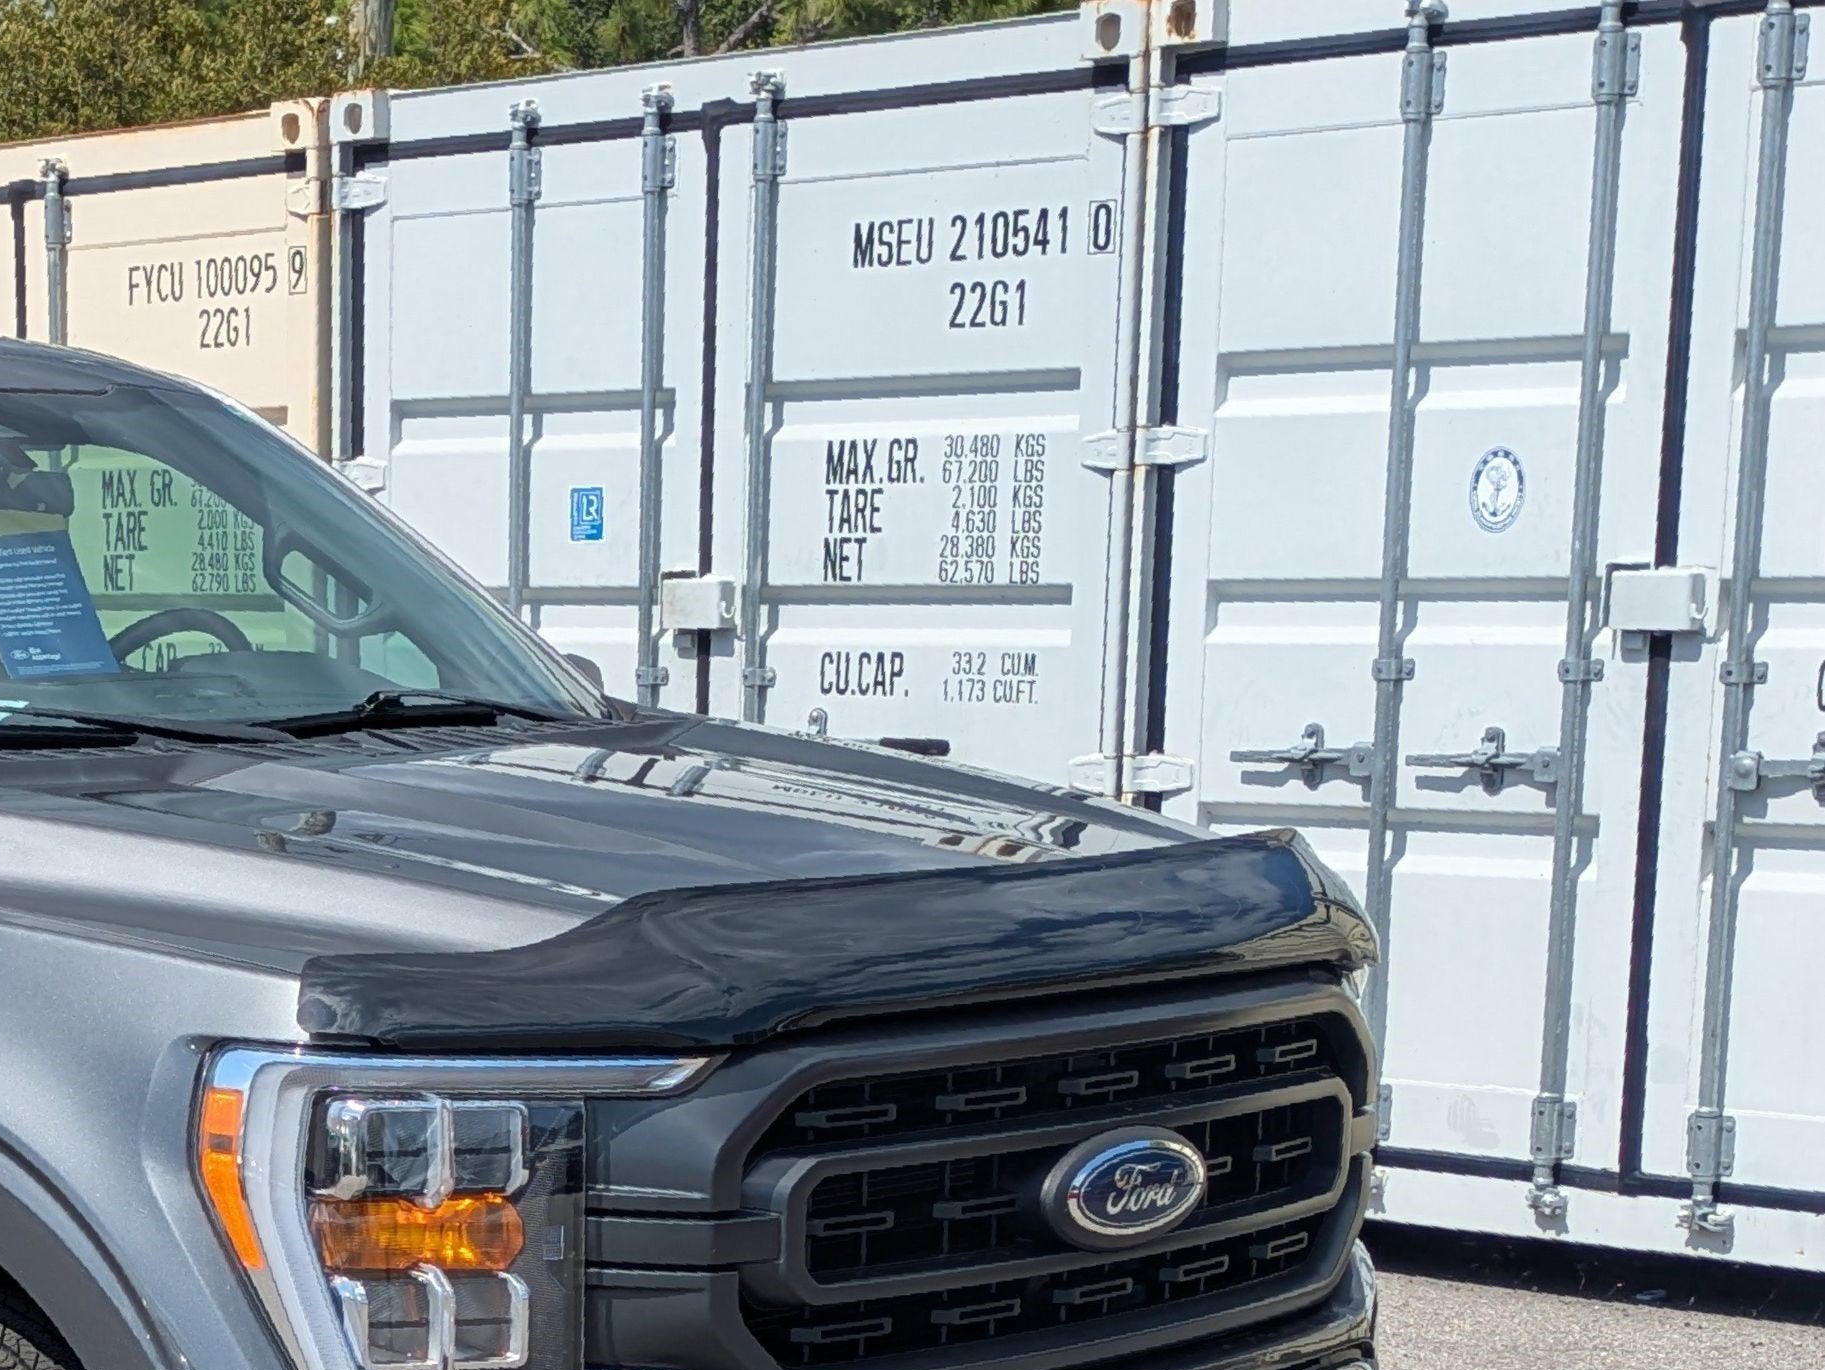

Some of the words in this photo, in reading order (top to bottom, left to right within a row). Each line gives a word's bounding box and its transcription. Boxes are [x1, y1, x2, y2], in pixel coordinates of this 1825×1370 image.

[853, 216, 934, 269] MSEU
[949, 206, 1069, 262] 210541
[128, 261, 183, 306] FYCU
[195, 252, 278, 299] 100095
[948, 278, 1026, 329] 22G1
[198, 306, 250, 349] 22G1
[826, 437, 925, 485] MAX.GR.
[944, 434, 1000, 459] 30.480
[1014, 433, 1046, 458] KGS
[942, 460, 999, 484] 67.200
[1013, 459, 1045, 483] LBS
[150, 469, 178, 508] GR.
[825, 487, 884, 534] TARE
[952, 484, 998, 510] 2.100
[1012, 484, 1044, 509] KGS
[102, 510, 149, 552] TARE
[233, 530, 256, 552] LBS
[951, 509, 996, 534] 4.630
[1011, 510, 1043, 534] LBS
[103, 553, 136, 592] NET
[234, 552, 257, 573] KGS
[824, 536, 867, 583] NET
[1010, 535, 1042, 560] KGS
[938, 560, 995, 584] 62.570
[1009, 560, 1040, 585] LBS
[234, 573, 257, 593] LBS
[1105, 1161, 1179, 1216] Ford
